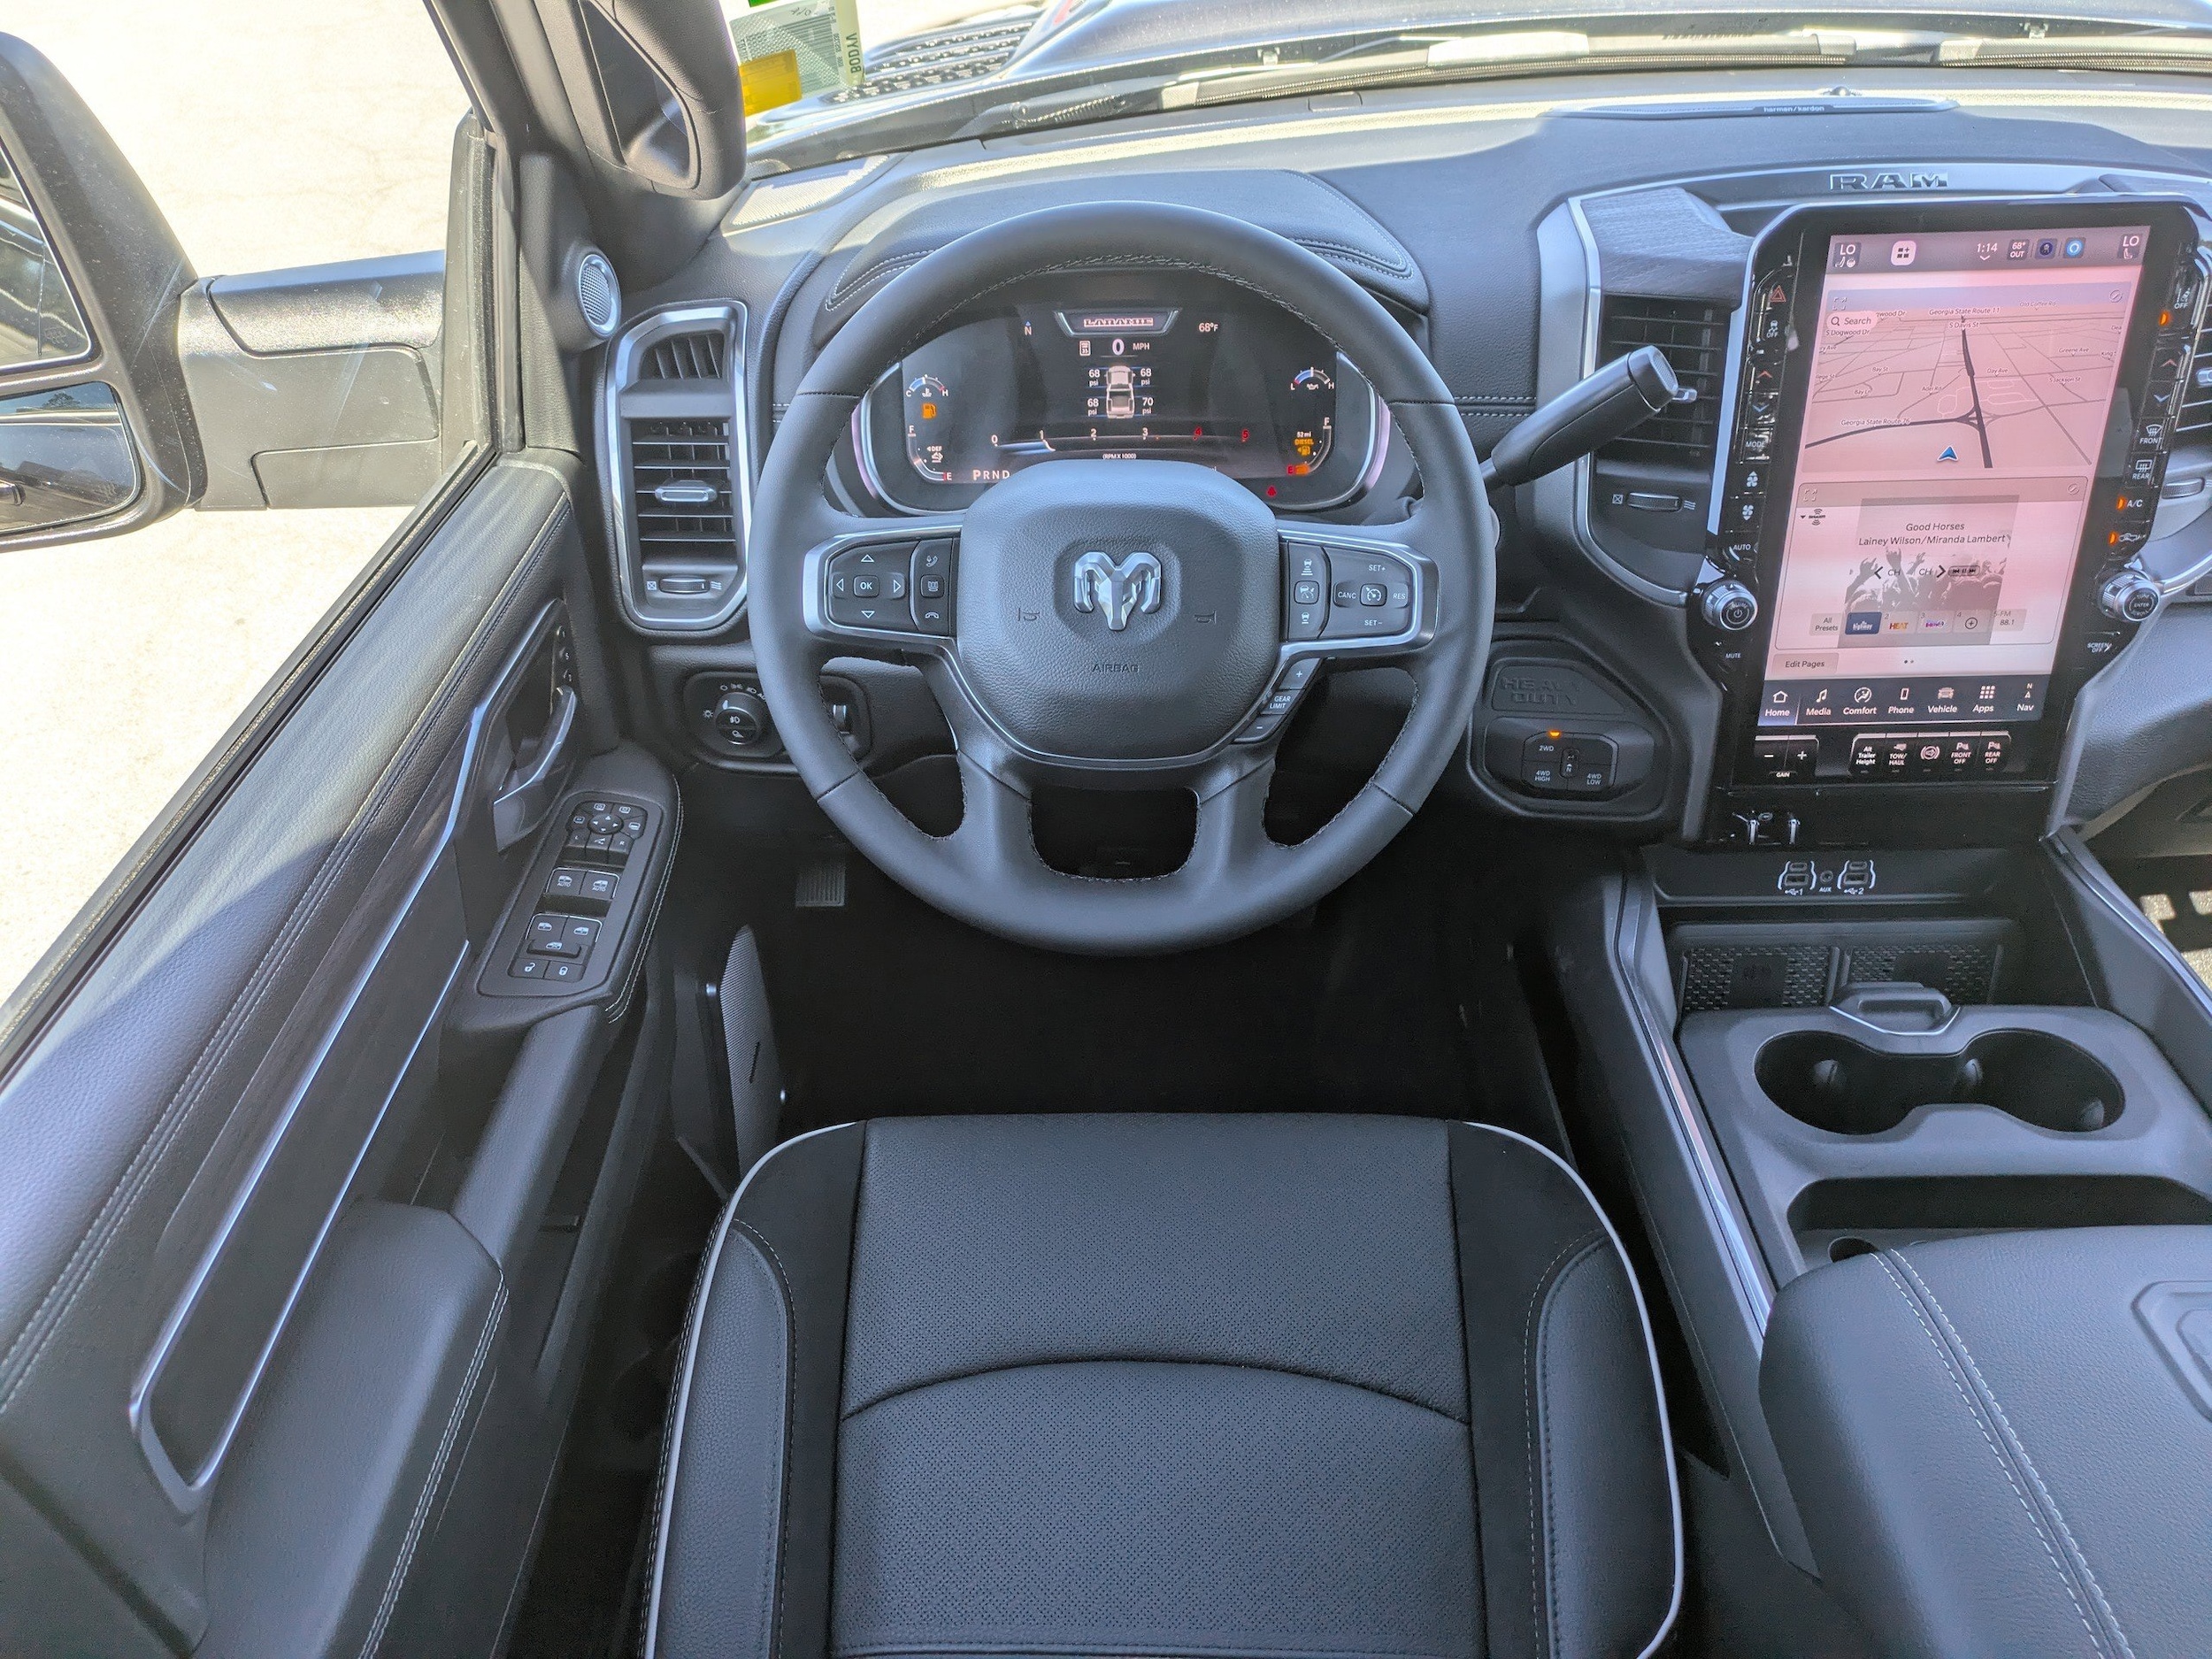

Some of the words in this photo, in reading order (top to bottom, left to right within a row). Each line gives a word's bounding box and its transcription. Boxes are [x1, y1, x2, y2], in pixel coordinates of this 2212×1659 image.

[1829, 173, 1947, 191] RAM
[2123, 235, 2139, 247] LO
[1840, 244, 1855, 255] LO
[1977, 242, 1998, 253] 1:14
[1084, 319, 1154, 327] LARAMIE
[1198, 322, 1219, 333] 68°F
[1025, 326, 1032, 335] N
[1112, 339, 1125, 355] 0
[1088, 369, 1101, 379] 68
[1141, 368, 1152, 377] 68
[1089, 379, 1099, 388] psi
[1141, 378, 1150, 387] psi
[1087, 398, 1099, 407] 68
[1142, 397, 1154, 406] 70
[1142, 407, 1152, 416] psi
[1090, 428, 1097, 437] 2
[1143, 427, 1148, 436] 3
[1196, 427, 1202, 436] 4
[1242, 429, 1249, 439] 5
[1287, 465, 1294, 474] E
[1858, 538, 1888, 547] Lainey
[1890, 535, 1965, 545] Wilson/Miranda
[1967, 534, 2006, 543] Lambert
[1092, 664, 1140, 673] AIRBAG
[1801, 660, 1825, 670] Pages
[1765, 708, 1790, 717] Home
[1843, 706, 1878, 715] Comfort
[1927, 704, 1957, 713] Vehicle
[1973, 704, 1994, 714] Apps
